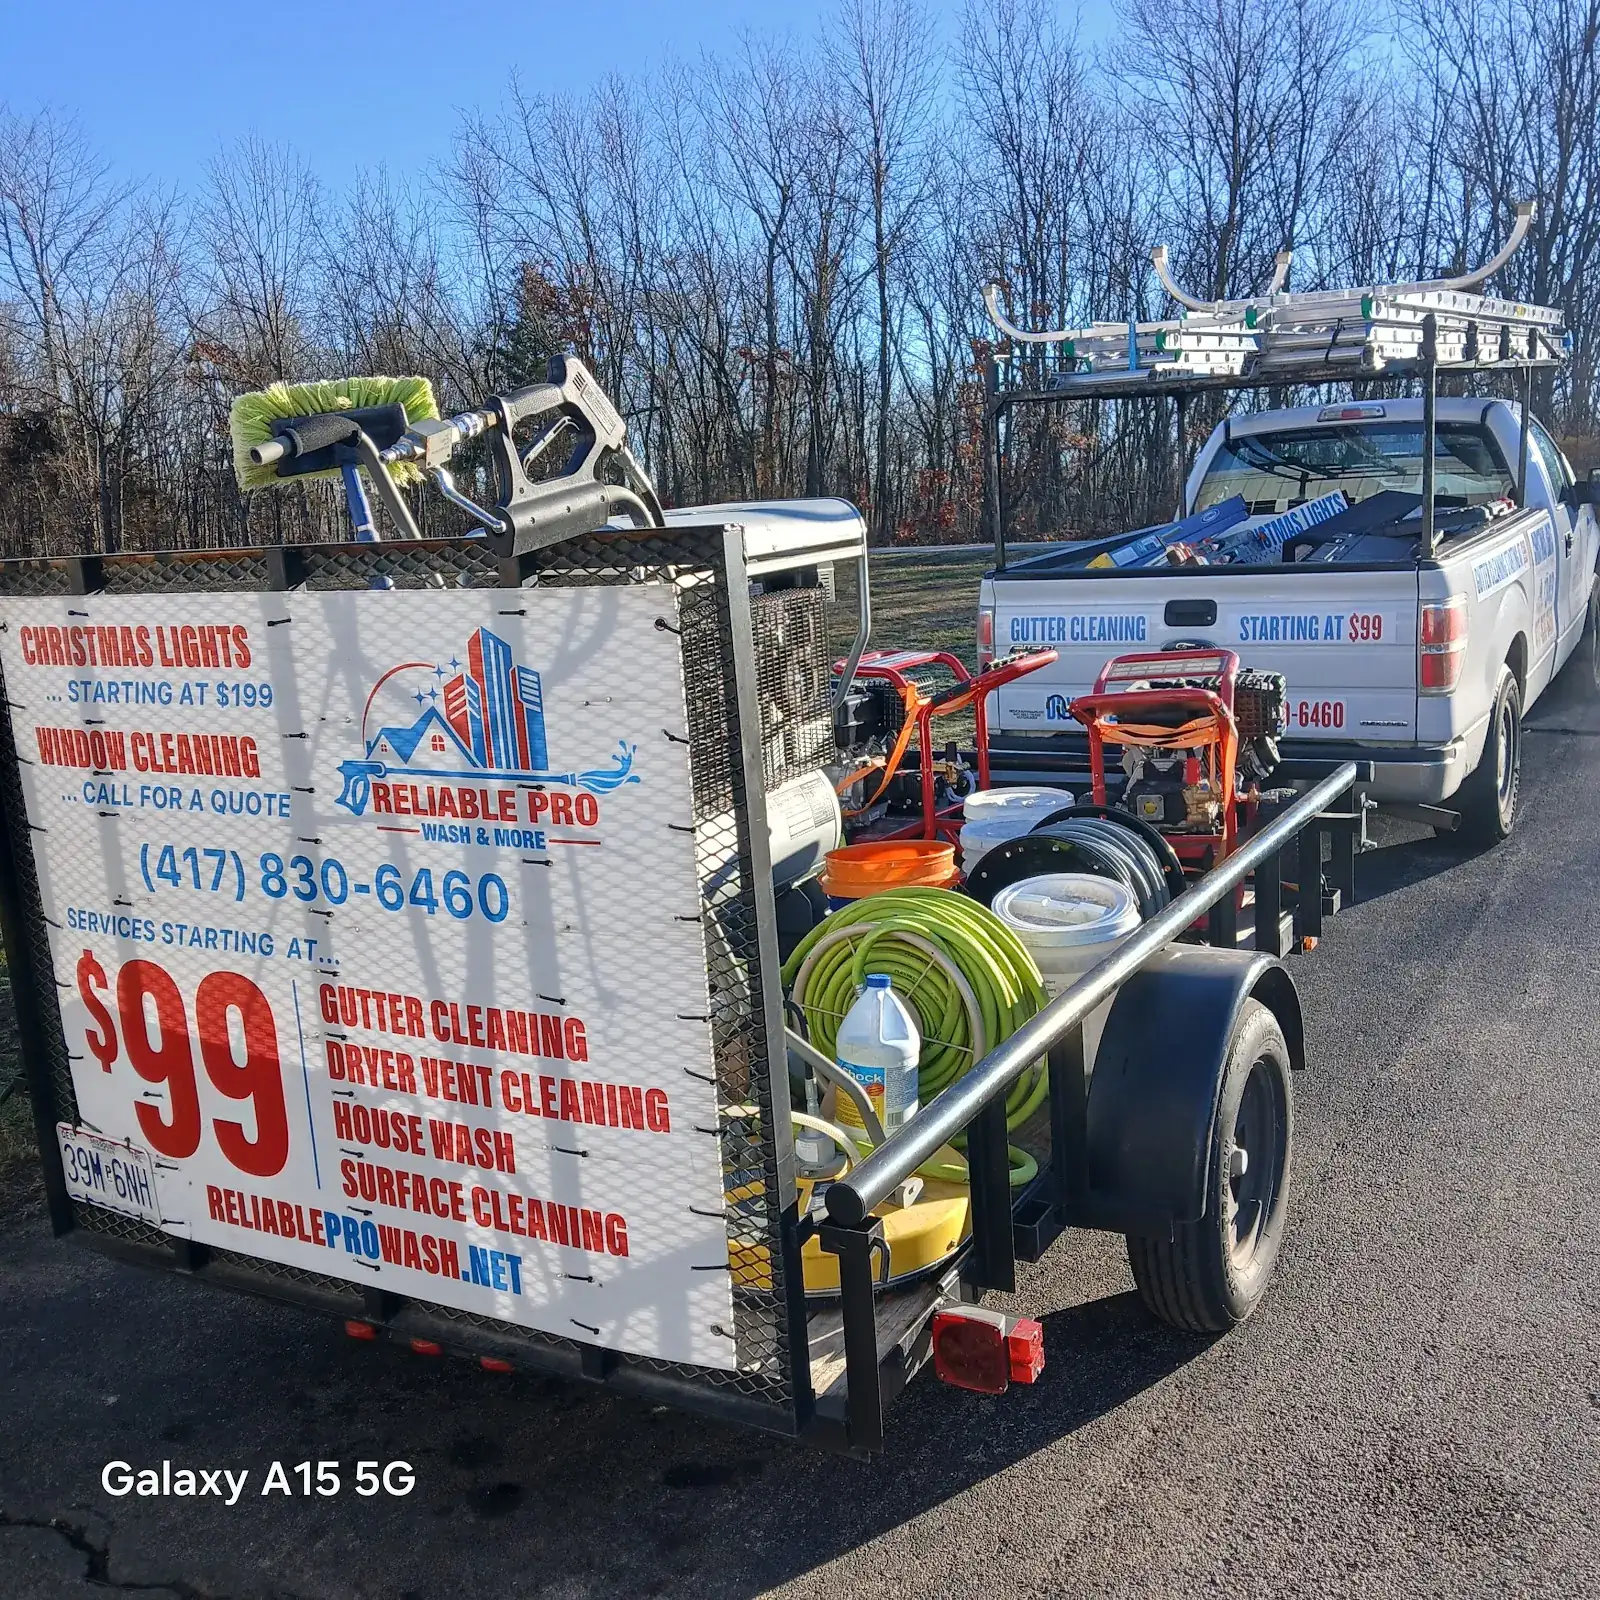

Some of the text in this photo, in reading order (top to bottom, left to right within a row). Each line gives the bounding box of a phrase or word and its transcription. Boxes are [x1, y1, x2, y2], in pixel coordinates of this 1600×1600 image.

[1300, 492, 1346, 528] LIGHTS
[20, 625, 251, 669] CHRISTMAS LIGHTS
[1010, 615, 1146, 642] GUTTER CLEANING
[1239, 612, 1382, 643] STARTING AT $99
[68, 680, 172, 705] STARTING
[179, 682, 208, 706] AT
[216, 681, 273, 708] $199
[35, 727, 260, 778] WINDOW CLEANING
[83, 781, 133, 806] CALL
[140, 785, 182, 811] FOR
[189, 789, 204, 812] A
[211, 789, 291, 818] QUOTE
[372, 783, 598, 826] RELIABLE PRO
[421, 823, 546, 850] WASH & MORE
[140, 843, 509, 923] (417) 830-6460
[67, 907, 156, 942] SERVICES
[161, 923, 274, 956] STARTING
[319, 983, 588, 1062] GUTTER CLEANING
[76, 949, 289, 1177] $99
[326, 1040, 671, 1133] DRYER VENT CLEANING
[333, 1100, 516, 1174] HOUSE WASH
[340, 1158, 629, 1257] SURFACE CLEANING
[206, 1185, 522, 1295] RELIABLEPROWASH.NET
